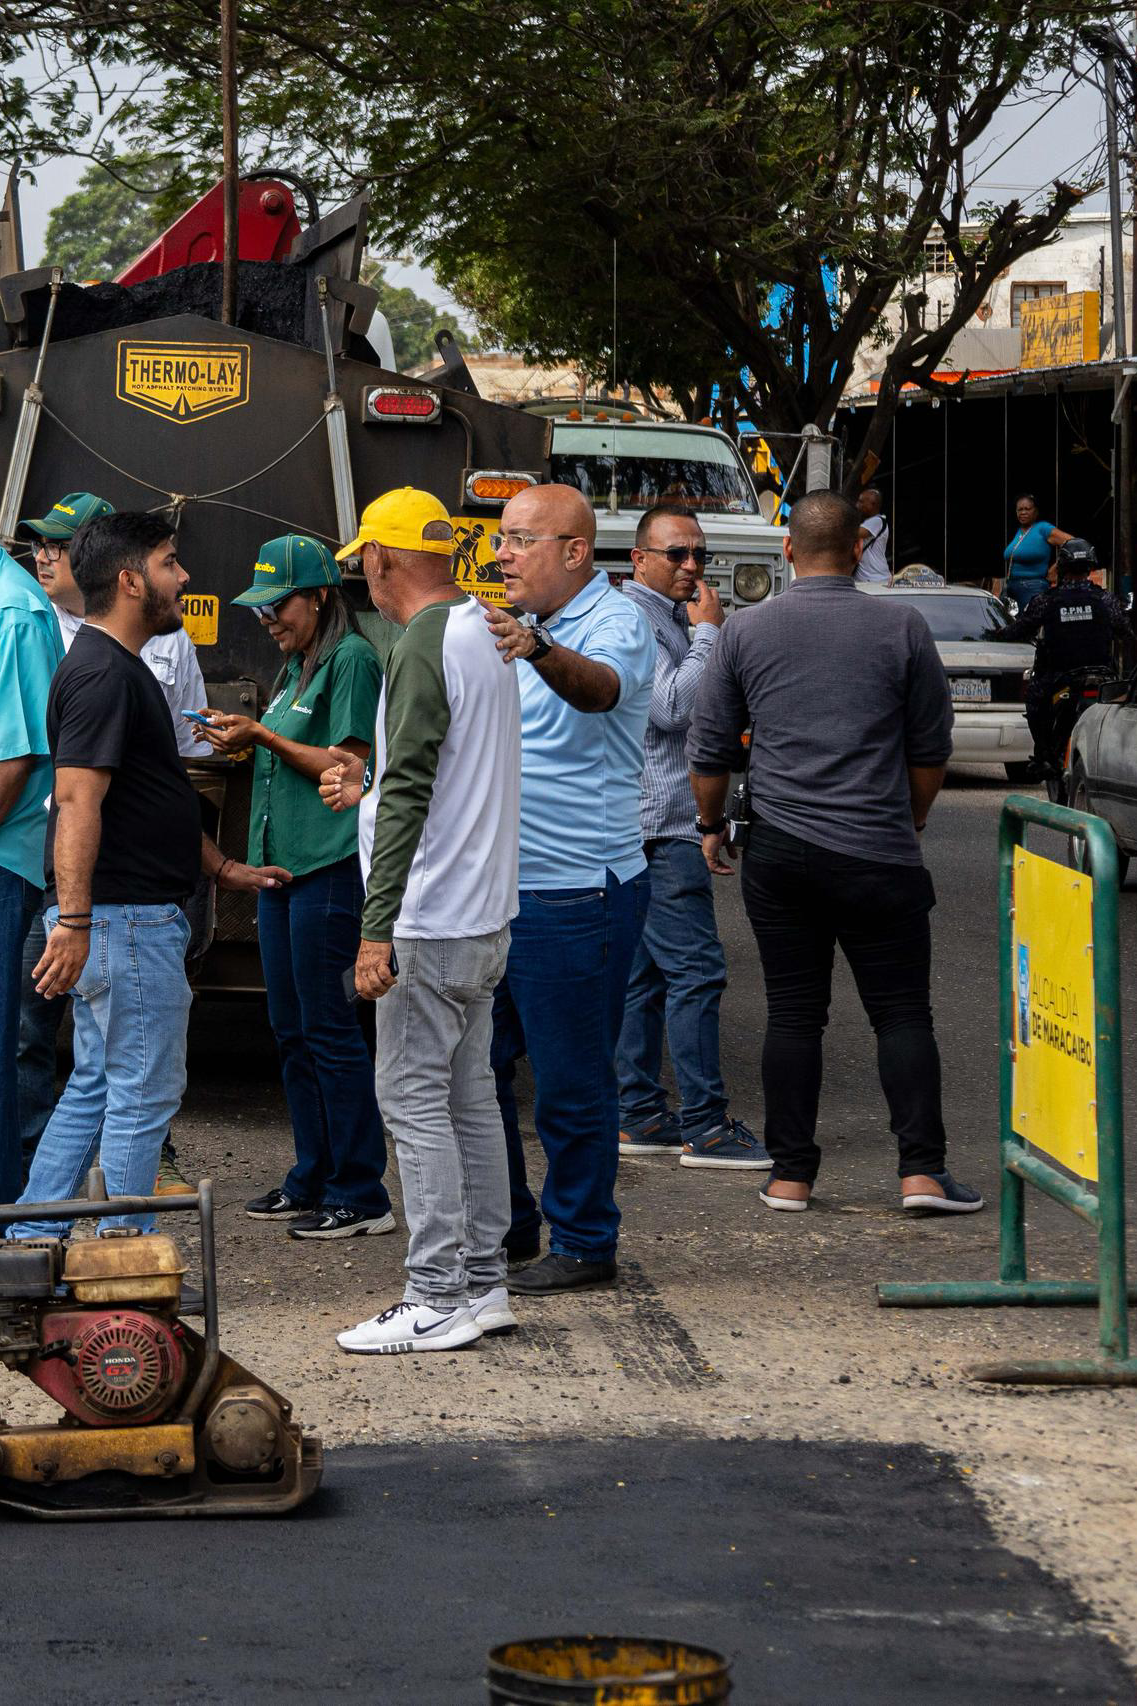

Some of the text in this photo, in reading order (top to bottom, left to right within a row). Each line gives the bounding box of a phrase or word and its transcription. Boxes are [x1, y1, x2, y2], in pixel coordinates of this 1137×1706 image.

[130, 359, 238, 385] THERMO-LAY
[183, 598, 214, 617] ION
[1032, 971, 1079, 1026] ALCALDÍA
[1032, 1011, 1092, 1068] DE MARACAIBO
[104, 1356, 136, 1364] HONDA
